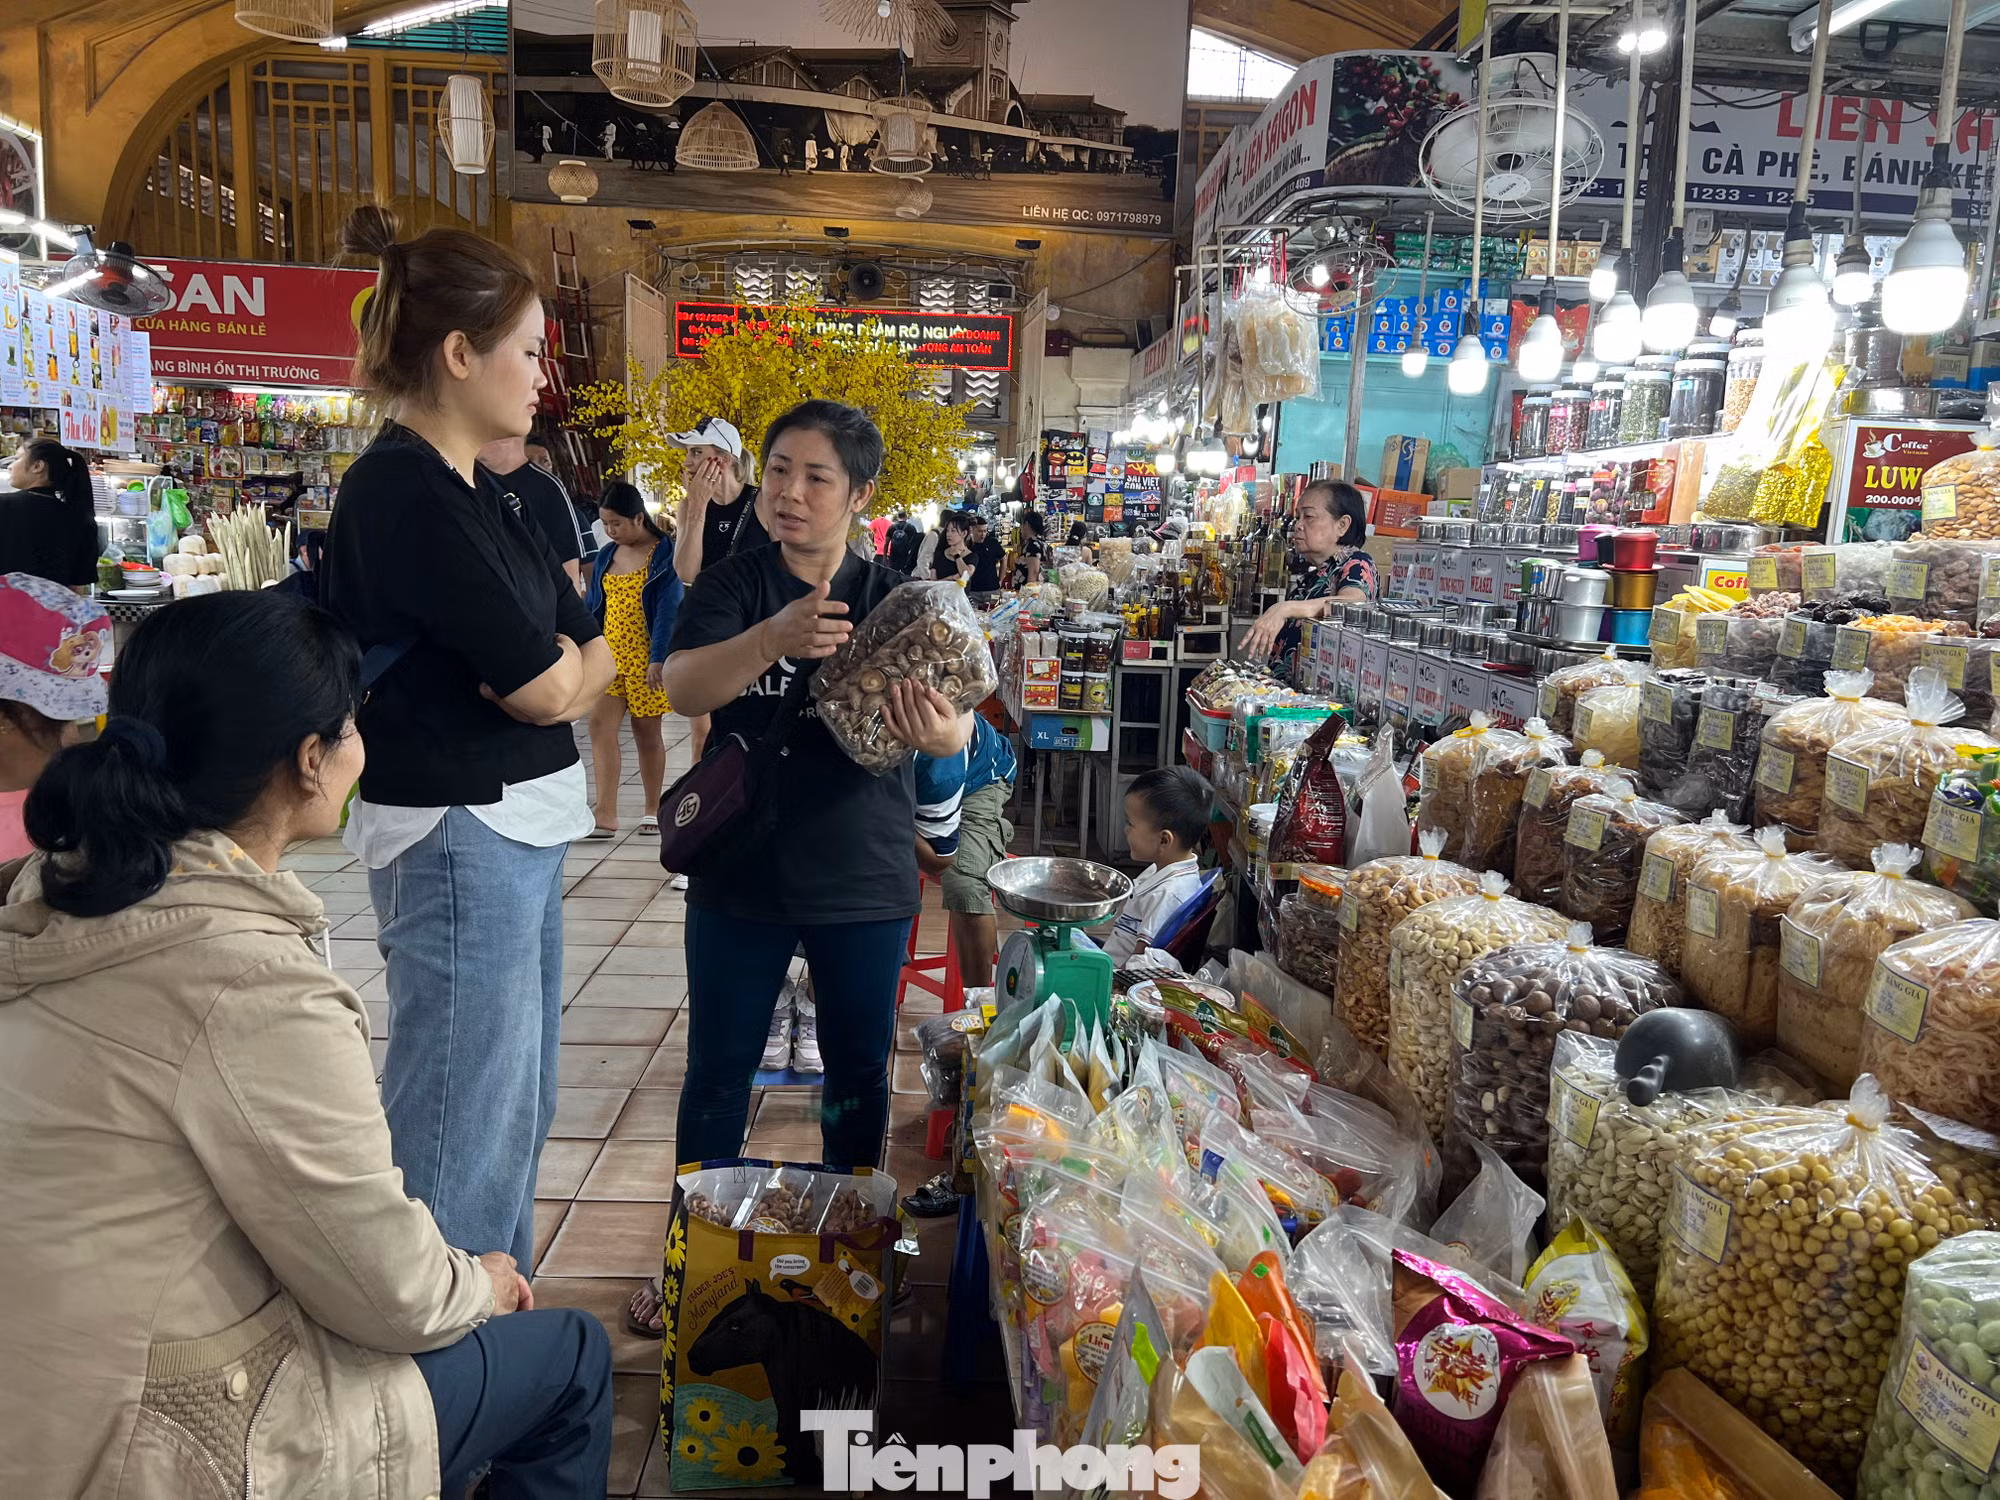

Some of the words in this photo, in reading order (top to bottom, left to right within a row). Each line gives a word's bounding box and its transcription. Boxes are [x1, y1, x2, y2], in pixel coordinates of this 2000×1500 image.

[1264, 79, 1318, 163] SAIGON
[1702, 143, 1744, 175] CÀ
[1296, 176, 1311, 189] 409
[1691, 187, 1740, 200] 1233
[1022, 205, 1049, 218] LIÊN
[1052, 208, 1069, 222] HỆ
[1072, 210, 1093, 221] QC:
[1096, 211, 1162, 225] 0971798979
[135, 318, 166, 331] CỬA
[169, 319, 211, 333] HÀNG
[217, 321, 248, 335] BÁN
[250, 322, 267, 336] LẺ
[177, 358, 211, 374] BÌNH
[214, 359, 235, 377] ỔN
[237, 364, 259, 381] THỊ
[261, 364, 320, 381] TRƯỜNG
[1883, 433, 1929, 452] Coffee
[1037, 731, 1049, 739] XL
[1905, 985, 1921, 1000] GIÁ
[1580, 1096, 1593, 1110] GIÁ
[1706, 1202, 1724, 1217] GIÁ
[687, 1280, 712, 1304] TRADER
[713, 1267, 735, 1284] JOE'S
[688, 1275, 736, 1330] Maryland
[1936, 1368, 1968, 1400] BẢNG
[1970, 1395, 1996, 1418] GIÁ
